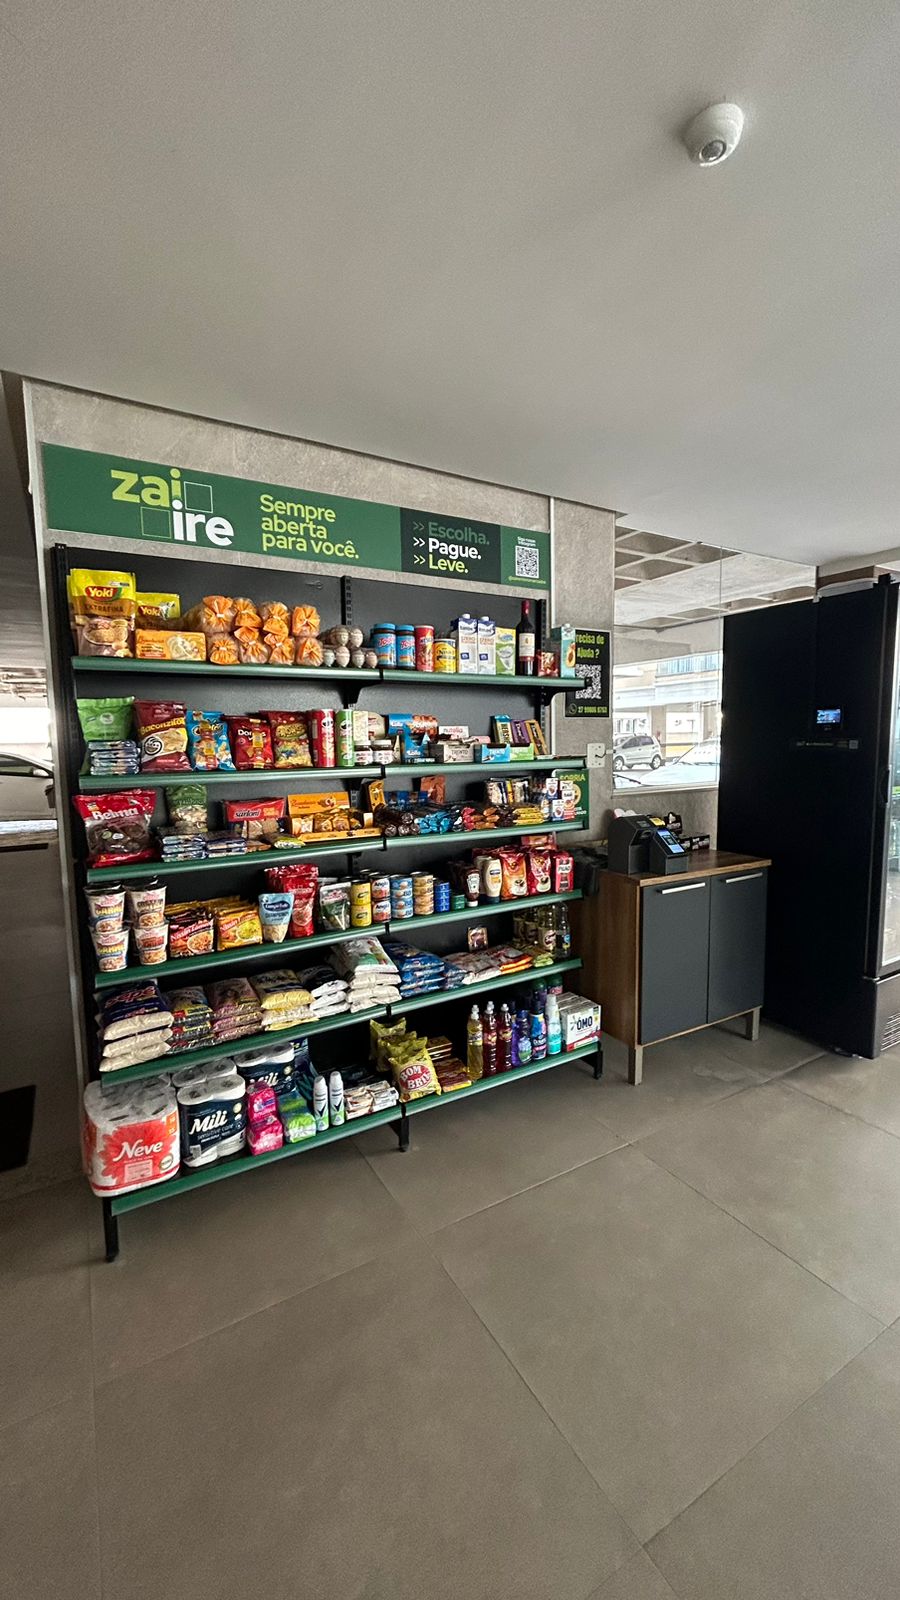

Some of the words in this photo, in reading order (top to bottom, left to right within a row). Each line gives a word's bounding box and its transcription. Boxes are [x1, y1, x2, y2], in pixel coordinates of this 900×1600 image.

[110, 468, 182, 508] zai
[260, 494, 336, 523] Sempre
[172, 499, 234, 546] ire
[261, 514, 328, 539] aberta
[428, 521, 489, 545] Escolha.
[262, 533, 307, 551] para
[310, 540, 359, 559] você.
[428, 538, 481, 560] Pague.
[429, 554, 468, 573] Leve.
[89, 588, 113, 597] Yoki
[596, 634, 605, 645] de
[401, 1065, 422, 1080] BOM
[189, 1110, 228, 1135] Mili
[112, 1139, 164, 1162] Neve
